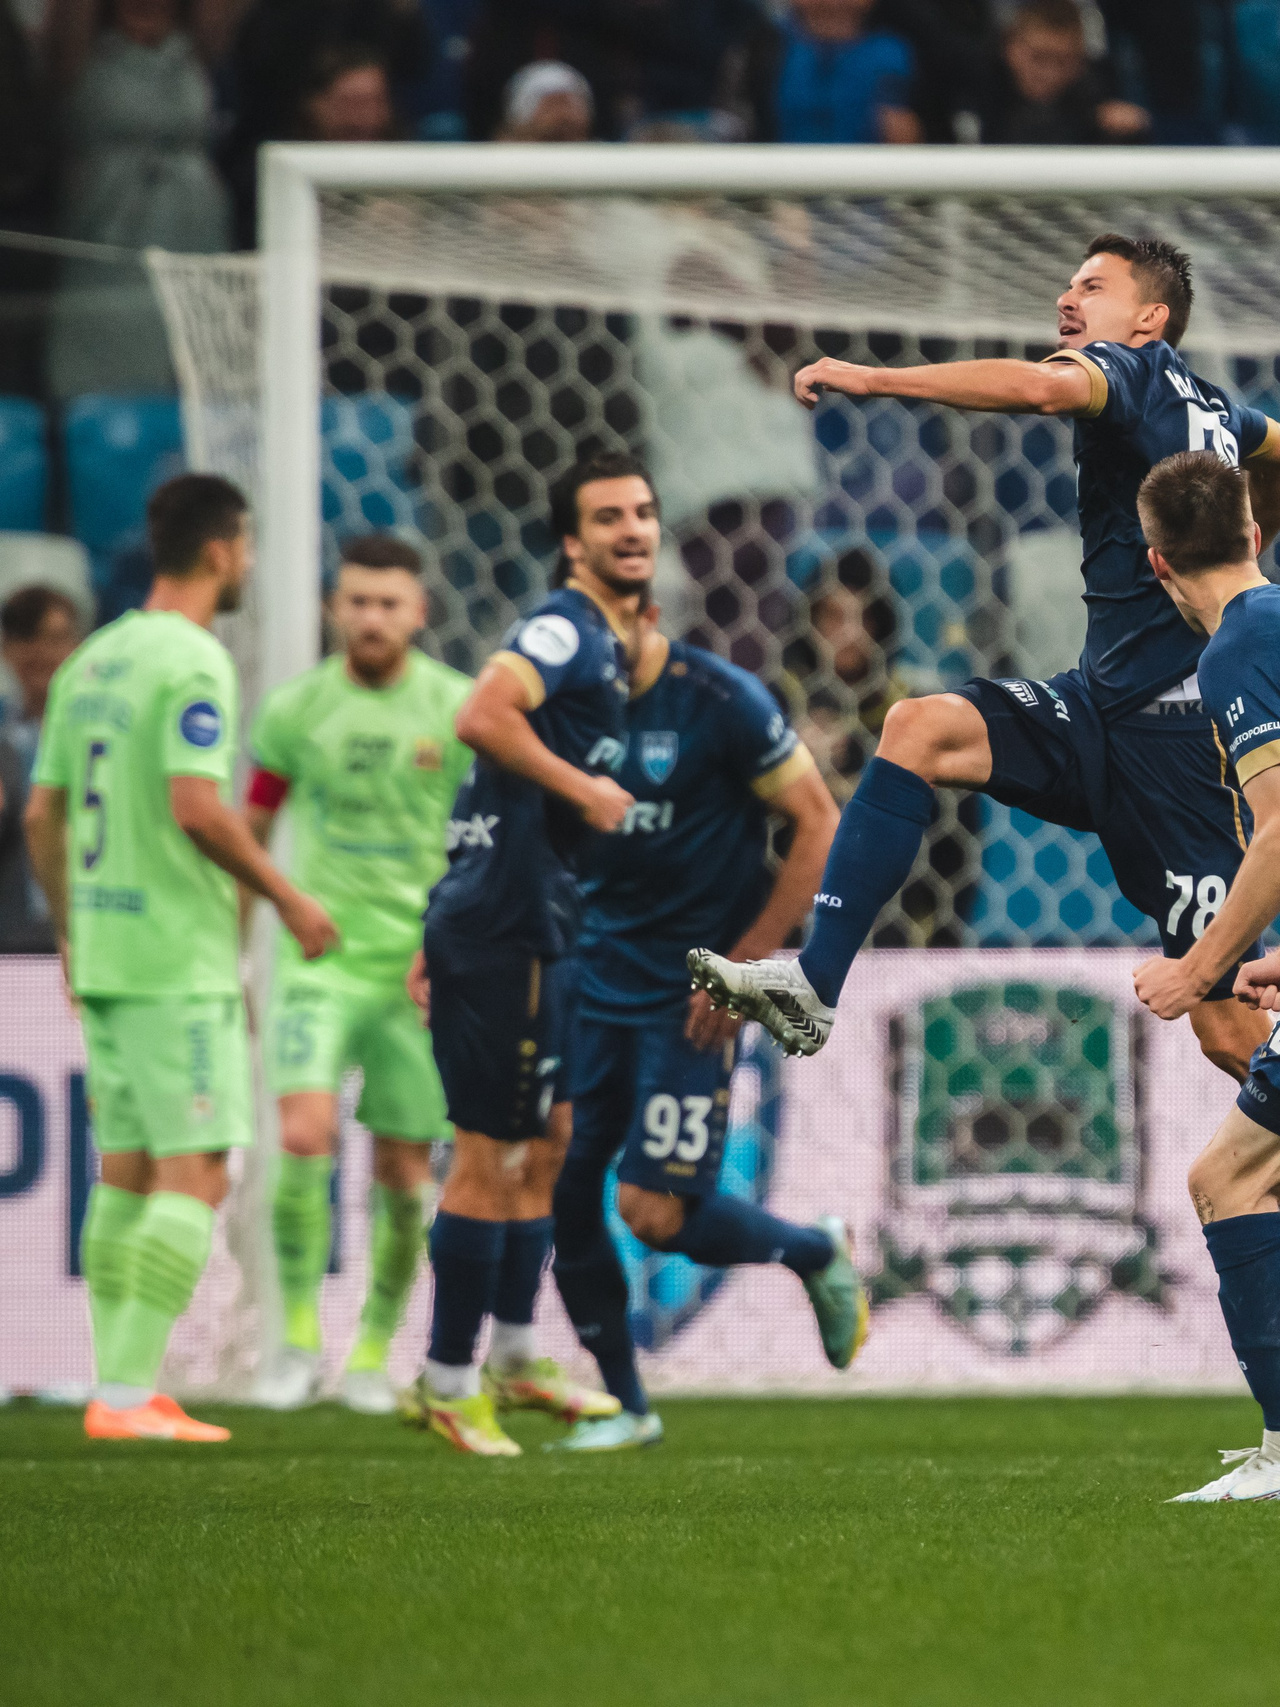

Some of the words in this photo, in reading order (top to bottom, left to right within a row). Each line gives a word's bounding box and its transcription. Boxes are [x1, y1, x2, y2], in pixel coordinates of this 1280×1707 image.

[85, 740, 110, 872] 5
[1165, 869, 1227, 938] 78
[642, 1093, 713, 1163] 93
